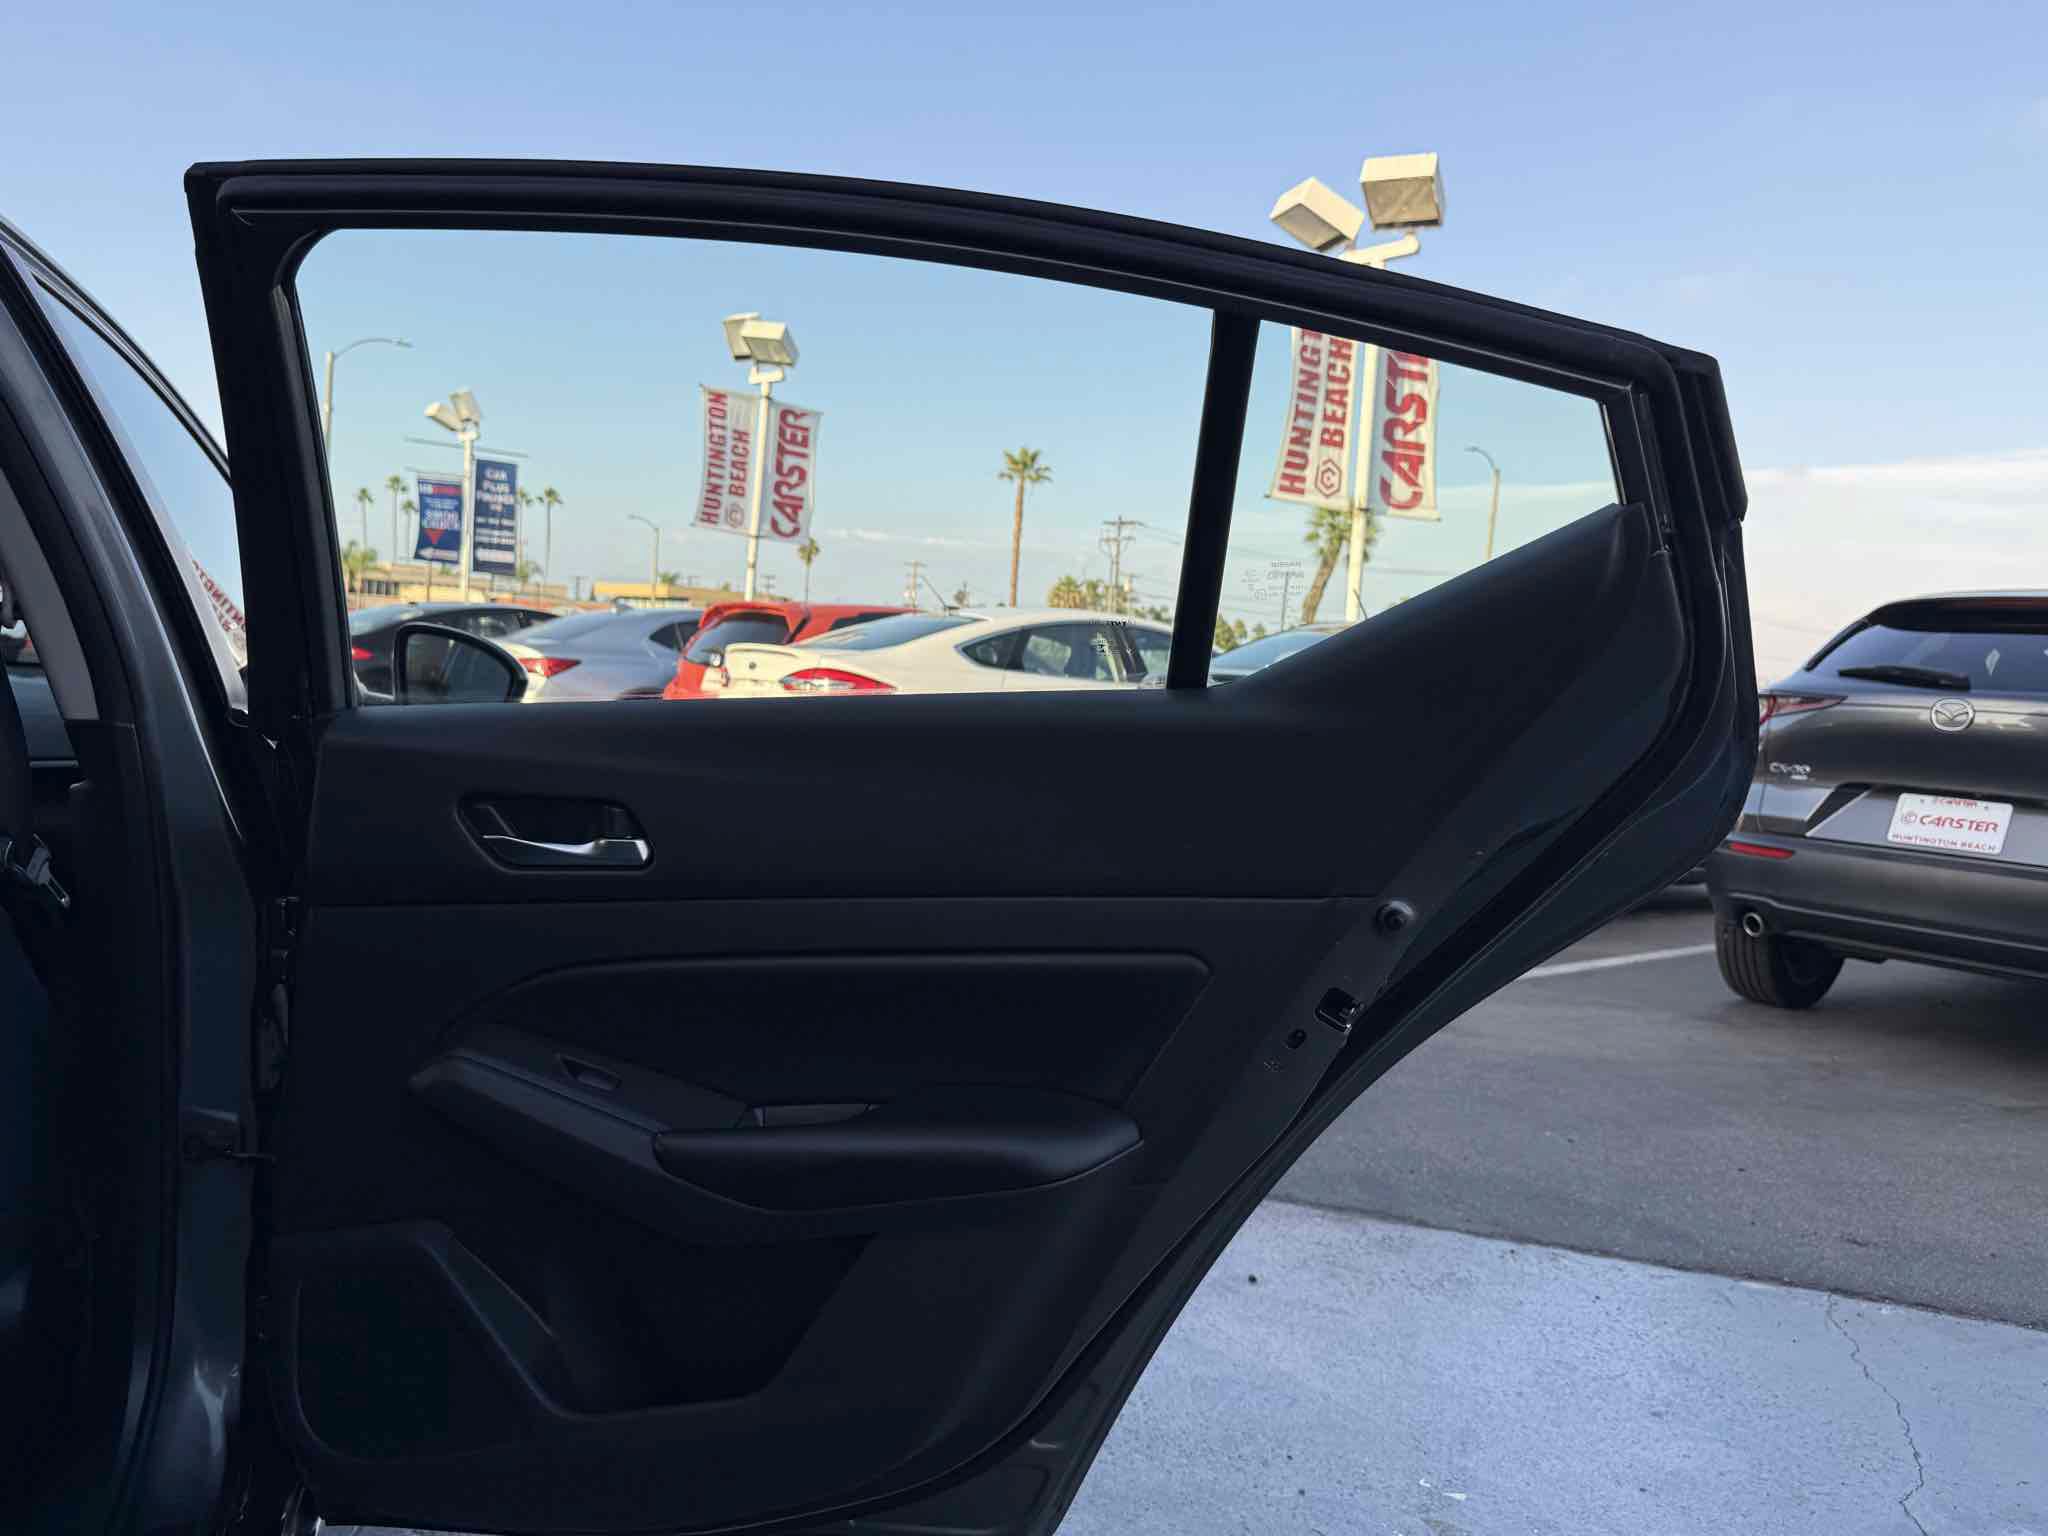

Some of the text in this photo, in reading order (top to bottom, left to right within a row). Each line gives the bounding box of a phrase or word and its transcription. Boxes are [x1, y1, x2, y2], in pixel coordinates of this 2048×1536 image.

[1278, 328, 1323, 495] HUNTINGT
[1320, 337, 1353, 449] BEACH
[1379, 351, 1430, 510] CARST
[700, 391, 729, 525] HUNTINGTON
[729, 429, 750, 497] BEACH
[770, 408, 811, 538] CARSTER
[1892, 833, 1996, 852] HUNTINGTON BEACH
[1920, 815, 2000, 832] CARSTER
